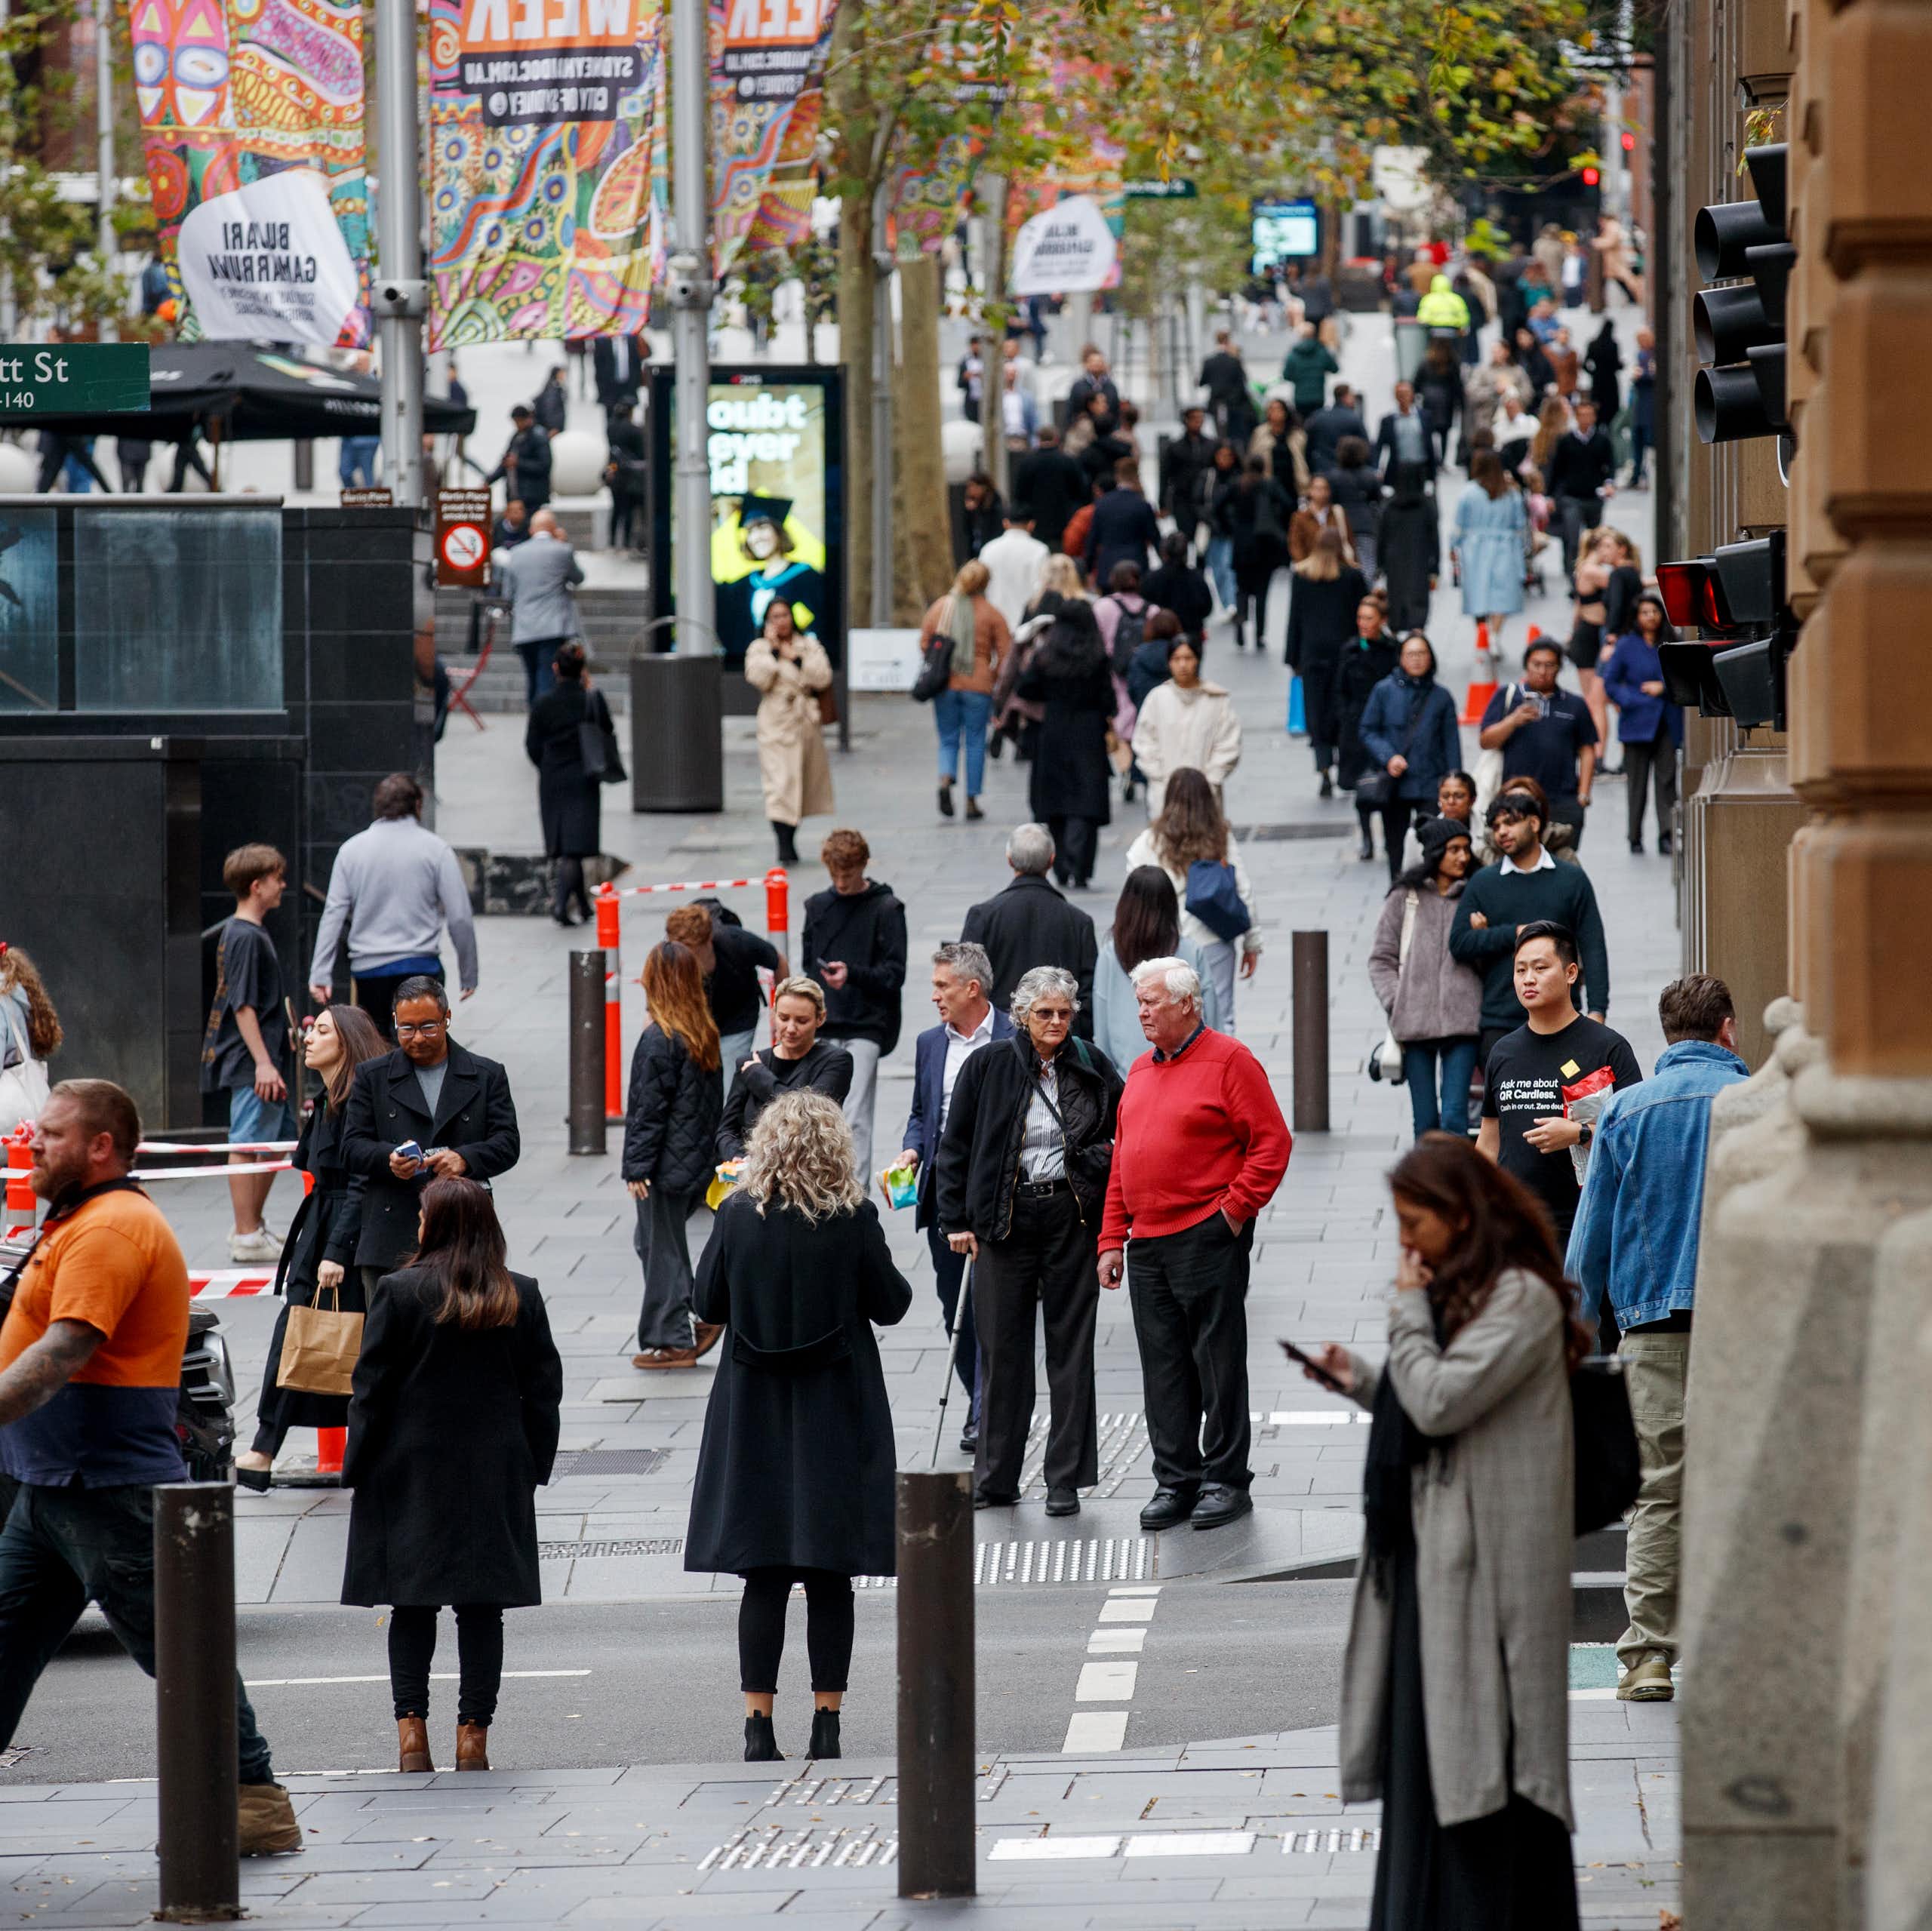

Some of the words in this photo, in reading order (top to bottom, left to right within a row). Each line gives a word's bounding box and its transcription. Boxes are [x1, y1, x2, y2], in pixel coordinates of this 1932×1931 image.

[35, 352, 69, 383] St
[708, 392, 808, 429] oubt
[708, 432, 801, 462] ever
[1500, 1079, 1515, 1090] Ask
[1516, 1080, 1531, 1088] me
[1533, 1078, 1558, 1088] about
[1500, 1090, 1512, 1101] QR
[1514, 1089, 1556, 1099] Cardless.
